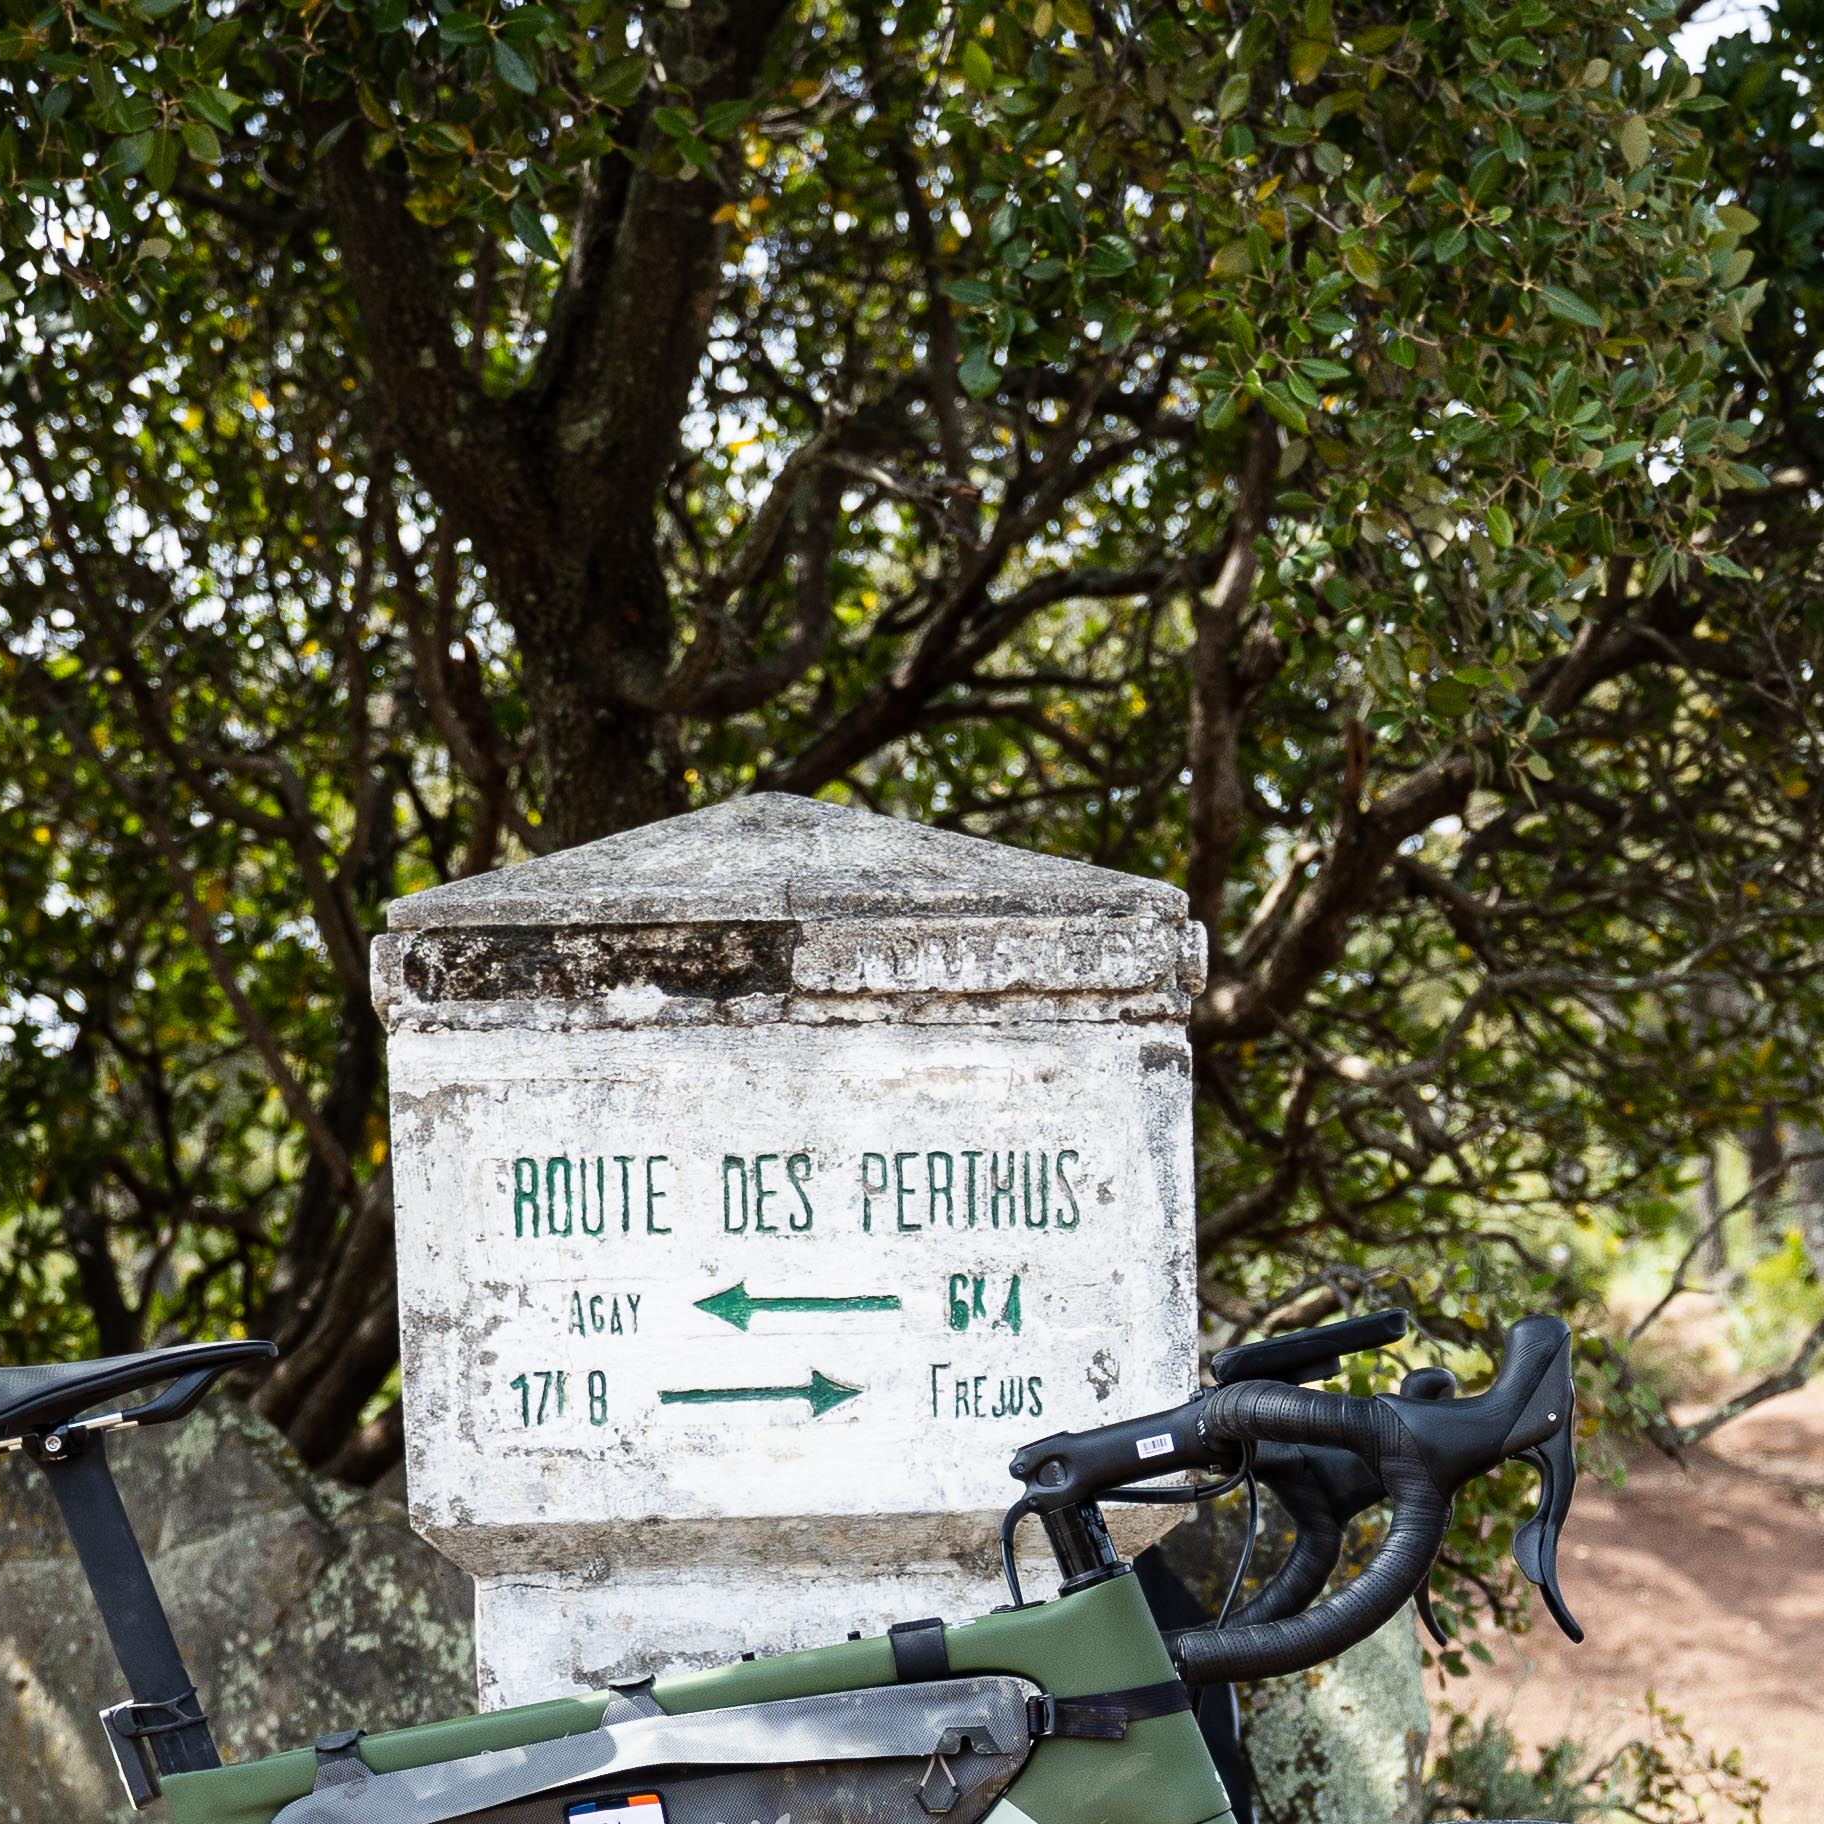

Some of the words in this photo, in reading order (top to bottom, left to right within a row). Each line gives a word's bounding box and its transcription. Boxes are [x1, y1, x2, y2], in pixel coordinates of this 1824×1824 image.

[513, 1155, 672, 1238] ROUTE
[723, 1152, 813, 1234] DES
[862, 1150, 1080, 1233] PERTHUS
[568, 1290, 641, 1338] AGAY
[929, 1361, 1043, 1419] FREJUS
